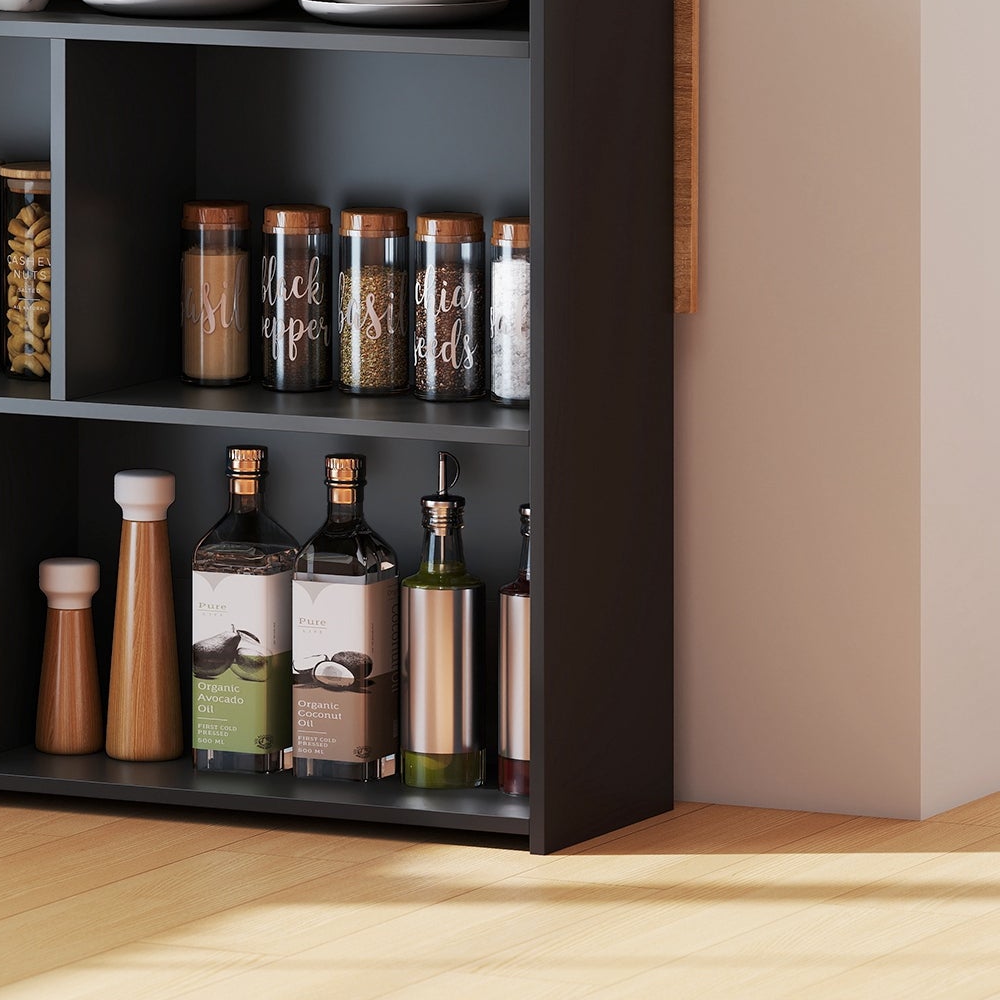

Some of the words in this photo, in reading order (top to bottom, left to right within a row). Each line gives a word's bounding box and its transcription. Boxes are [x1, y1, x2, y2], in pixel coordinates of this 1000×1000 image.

[13, 269, 47, 281] NUTS
[414, 264, 473, 318] chia
[261, 316, 330, 361] epper
[199, 602, 227, 610] Pure
[299, 617, 327, 627] Pure
[197, 681, 240, 693] Organic
[197, 693, 244, 705] Avocado
[197, 704, 214, 714] Oil
[297, 700, 340, 710] Organic
[297, 709, 342, 720] Coconut
[297, 719, 314, 728] Oil
[197, 729, 229, 737] PRESSED
